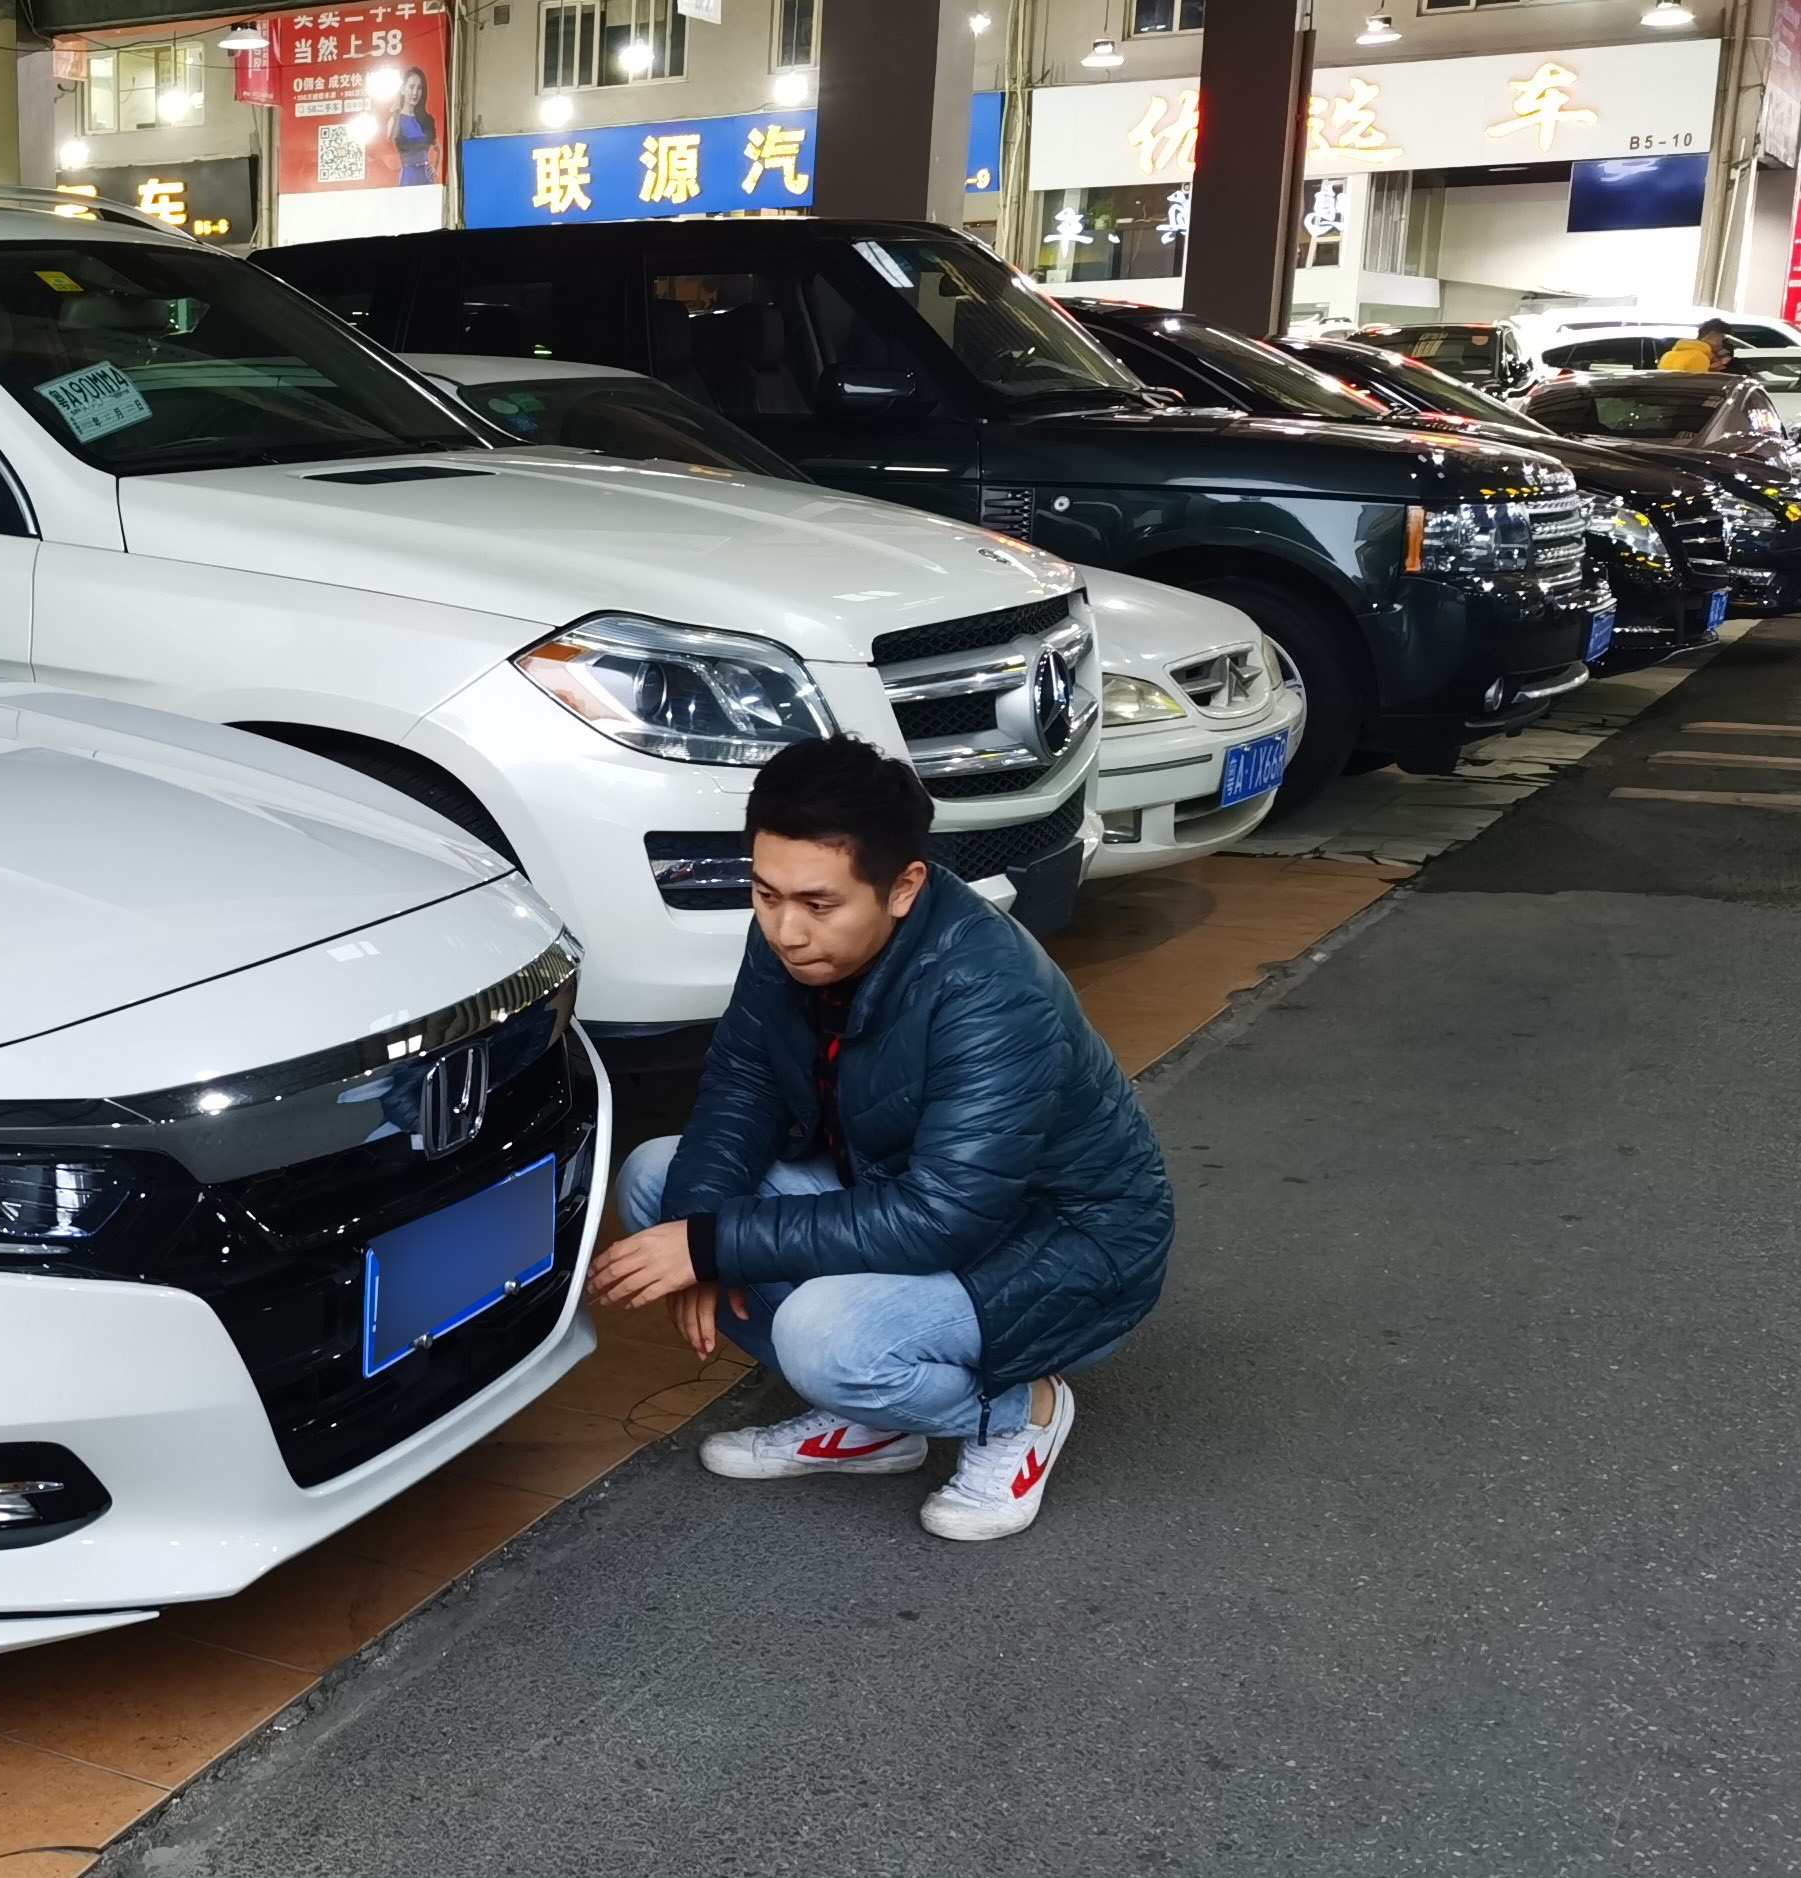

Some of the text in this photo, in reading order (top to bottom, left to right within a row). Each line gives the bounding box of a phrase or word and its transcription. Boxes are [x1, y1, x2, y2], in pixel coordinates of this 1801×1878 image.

[1628, 131, 1694, 151] B5-10
[532, 124, 809, 213] 联源汽
[965, 168, 991, 189] -9
